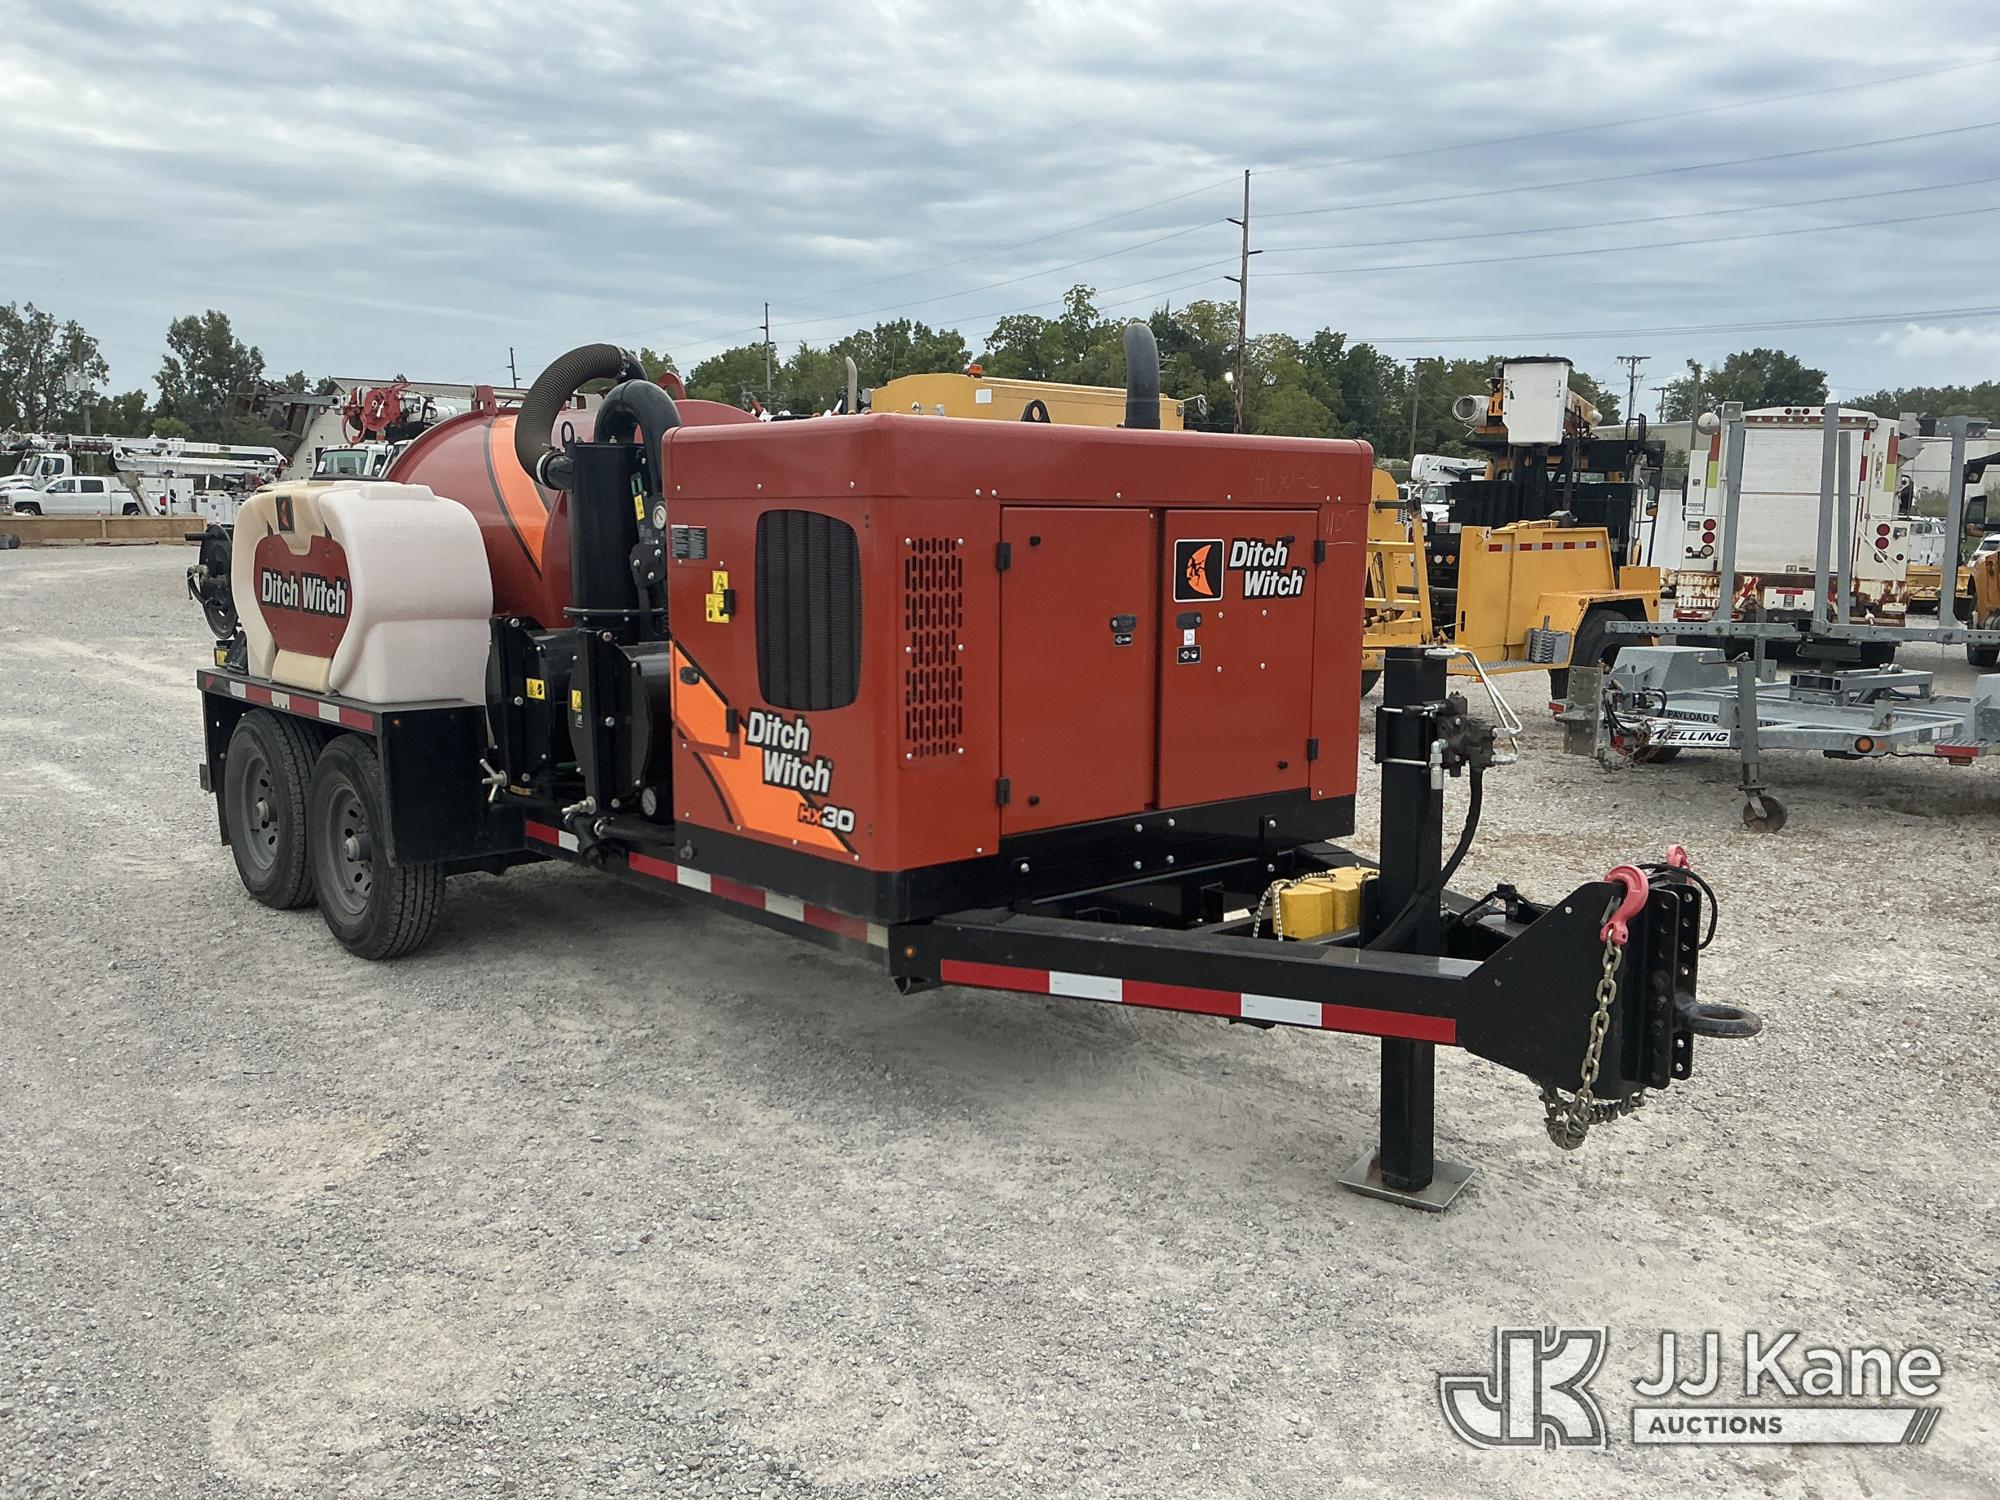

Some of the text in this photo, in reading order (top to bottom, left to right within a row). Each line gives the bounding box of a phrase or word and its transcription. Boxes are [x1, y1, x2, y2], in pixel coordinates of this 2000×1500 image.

[1229, 540, 1288, 567] Ditch
[262, 571, 346, 615] Ditch Witch
[1244, 569, 1304, 596] Witch
[1667, 710, 1710, 722] PAYLOAD
[747, 711, 810, 752] Ditch
[764, 749, 831, 793] Witch
[799, 803, 855, 832] HX30
